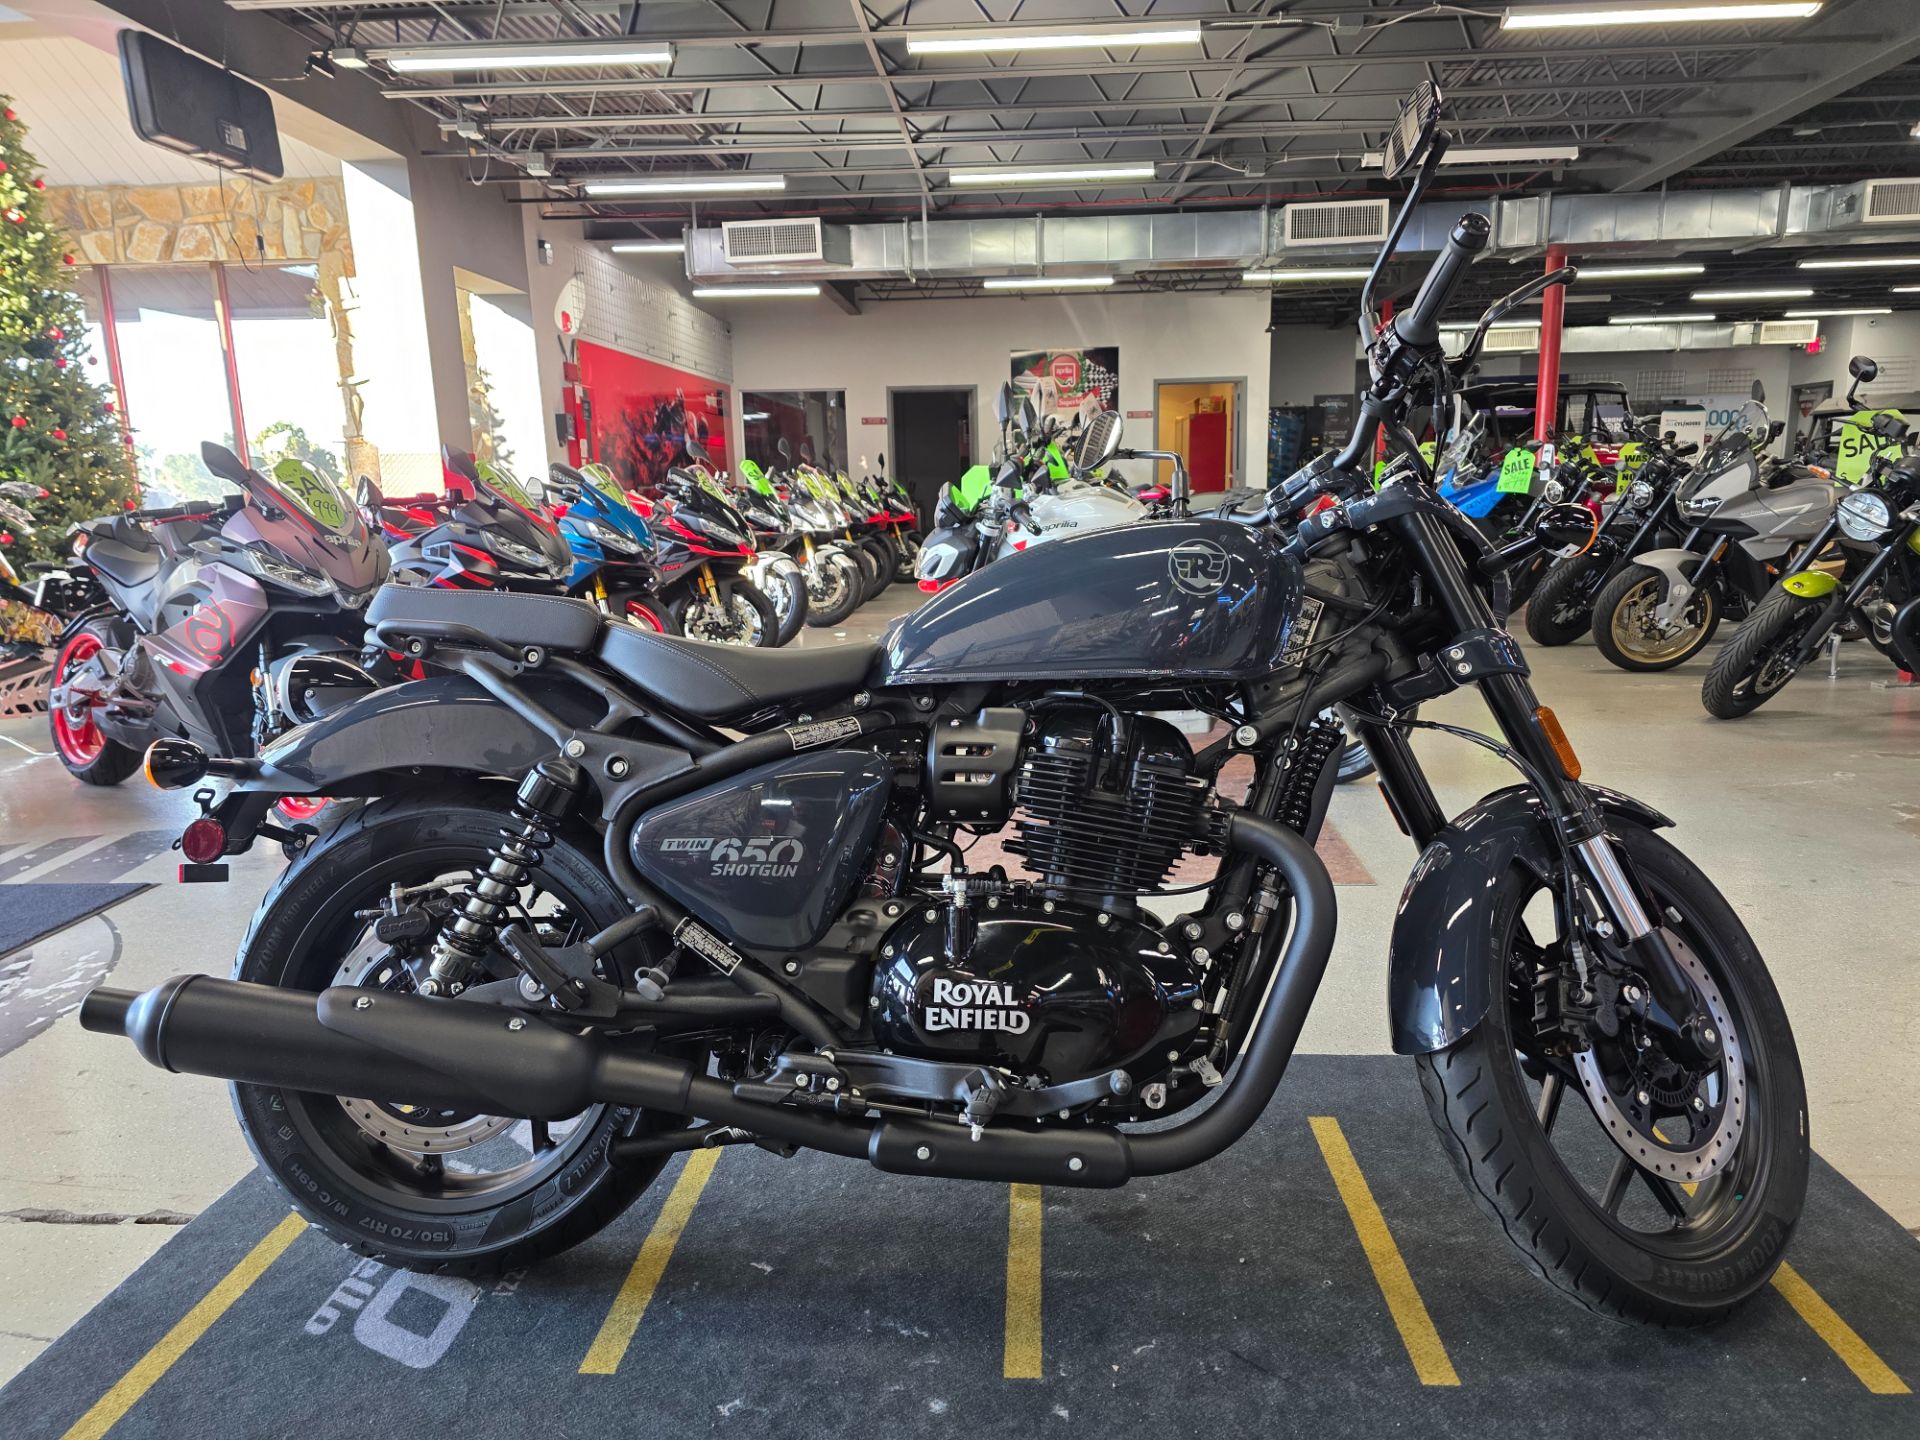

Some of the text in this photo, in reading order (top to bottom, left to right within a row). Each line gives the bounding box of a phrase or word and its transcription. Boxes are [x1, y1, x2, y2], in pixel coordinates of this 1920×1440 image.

[1504, 458, 1531, 476] SALE
[1624, 454, 1648, 464] WAS
[1042, 520, 1078, 532] aprilia
[666, 837, 804, 863] TWIN 650
[710, 863, 799, 878] SHOTGUN
[933, 977, 1019, 1007] ROYAL
[925, 1006, 1031, 1035] ENFIELD
[359, 1216, 388, 1234] R17
[390, 1226, 451, 1243] 150/70
